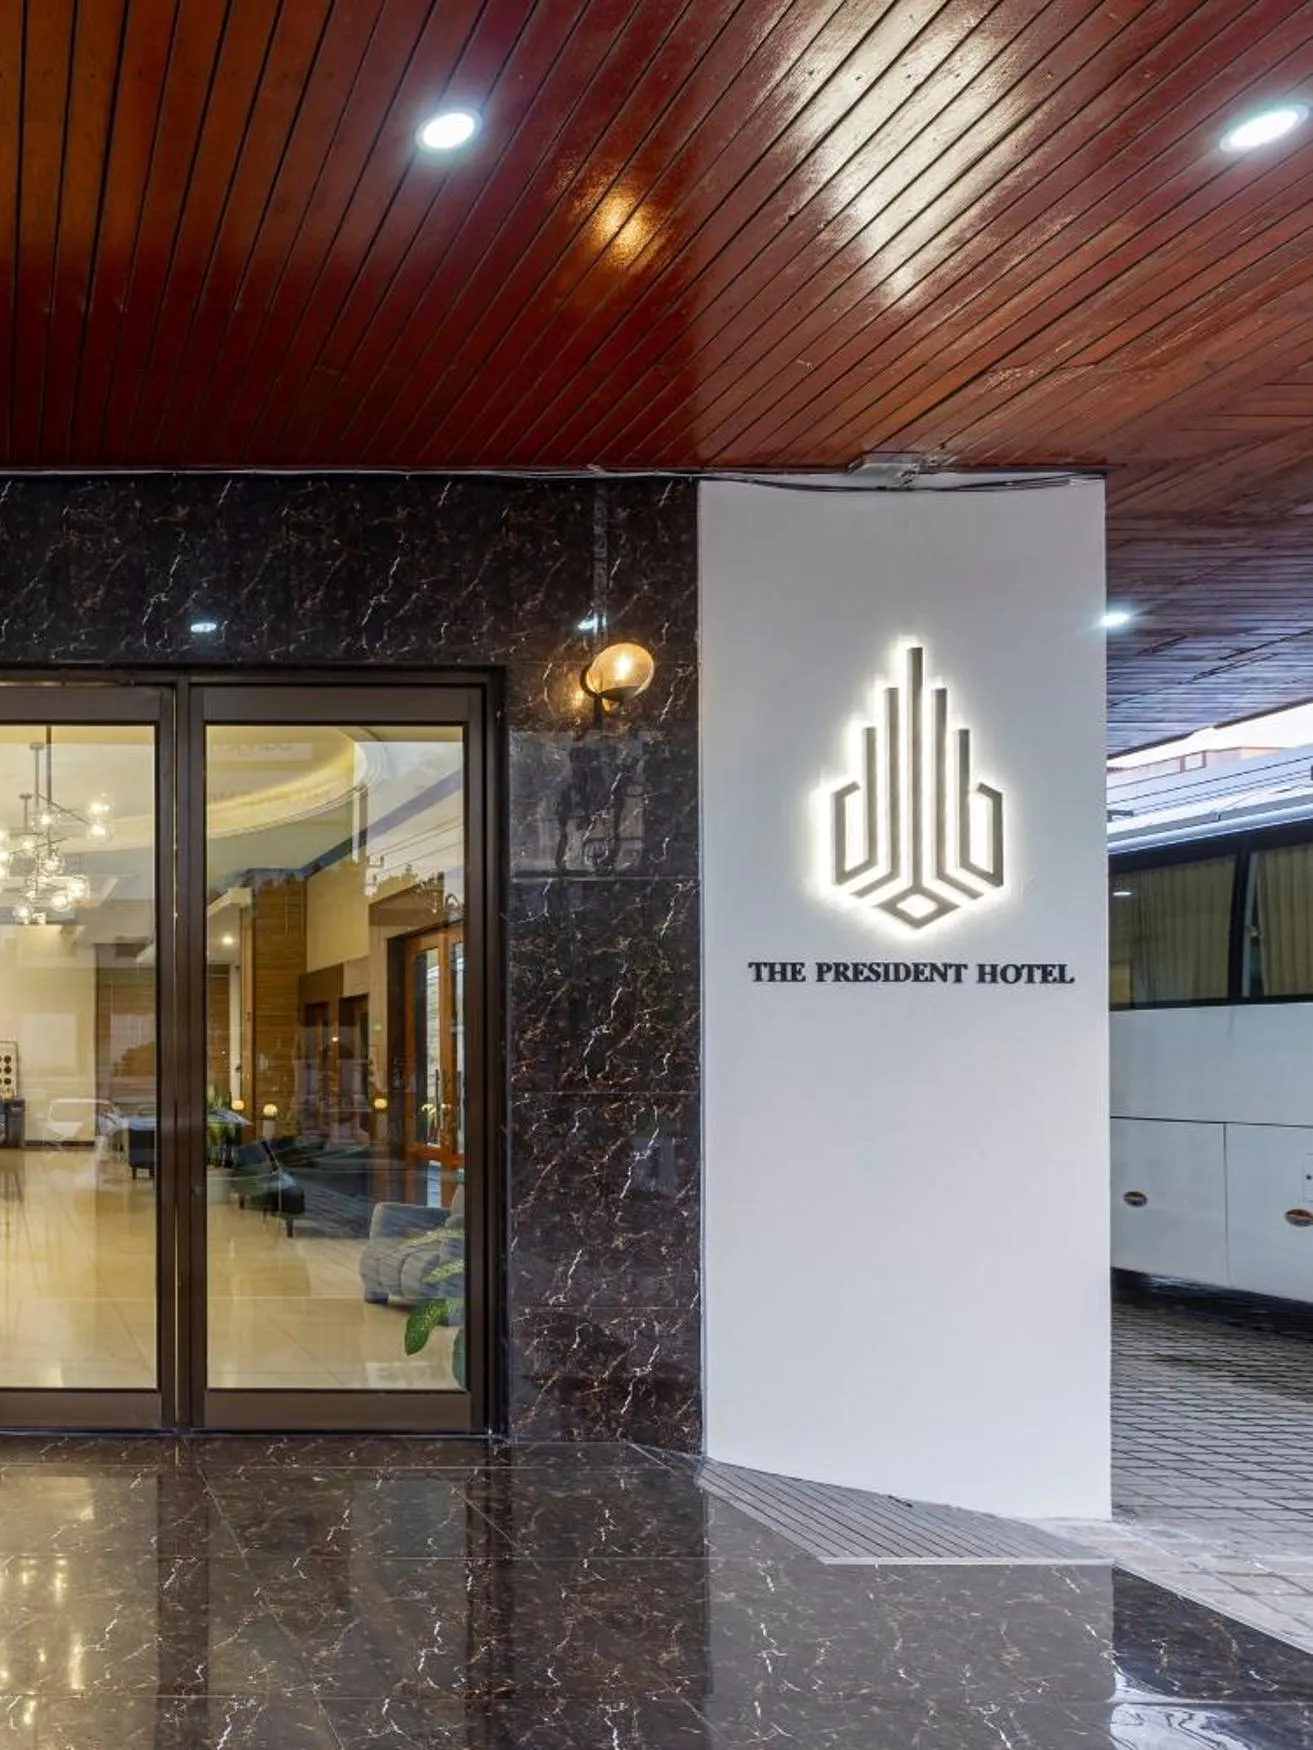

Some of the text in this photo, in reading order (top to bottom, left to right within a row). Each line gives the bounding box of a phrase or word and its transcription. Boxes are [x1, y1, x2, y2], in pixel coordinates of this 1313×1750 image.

[748, 961, 1076, 985] THE PRESIDENT HOTEL
